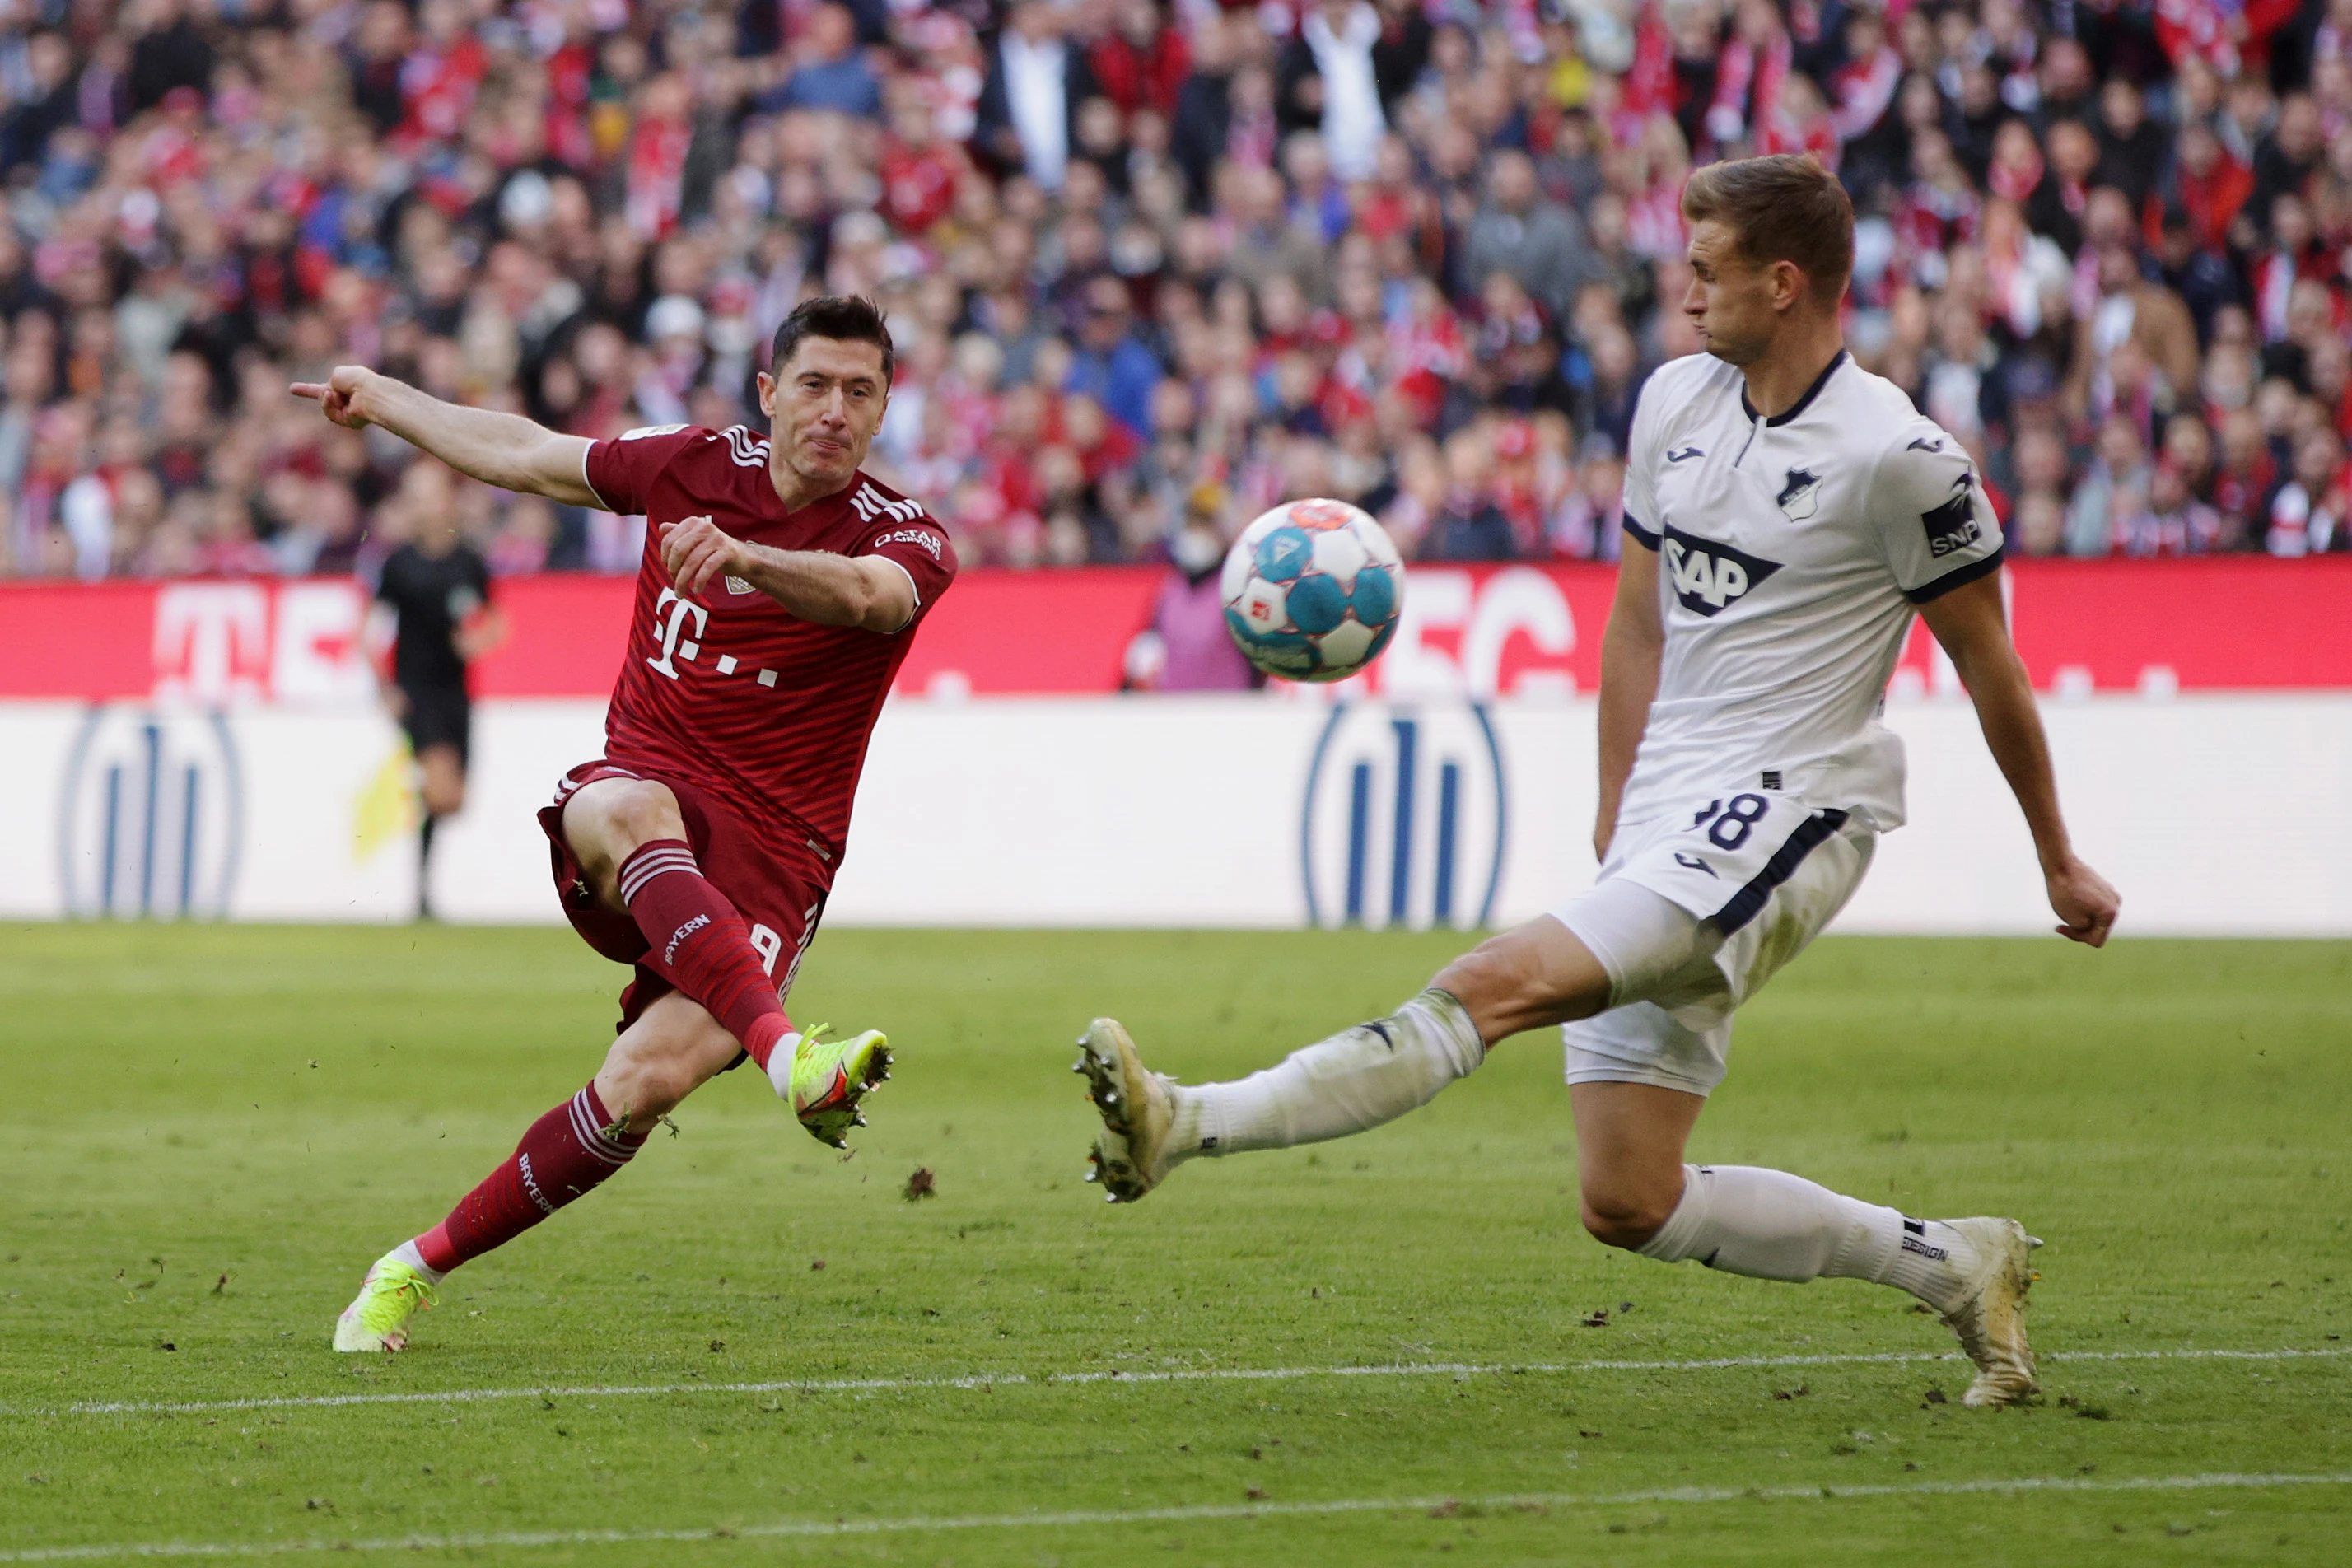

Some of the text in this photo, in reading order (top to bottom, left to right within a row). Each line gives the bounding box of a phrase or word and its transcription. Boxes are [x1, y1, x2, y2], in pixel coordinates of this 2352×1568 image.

[875, 530, 942, 548] QATAR
[1931, 520, 1978, 554] SNP
[1664, 538, 1748, 608] SAP
[665, 913, 712, 966] BAYERN
